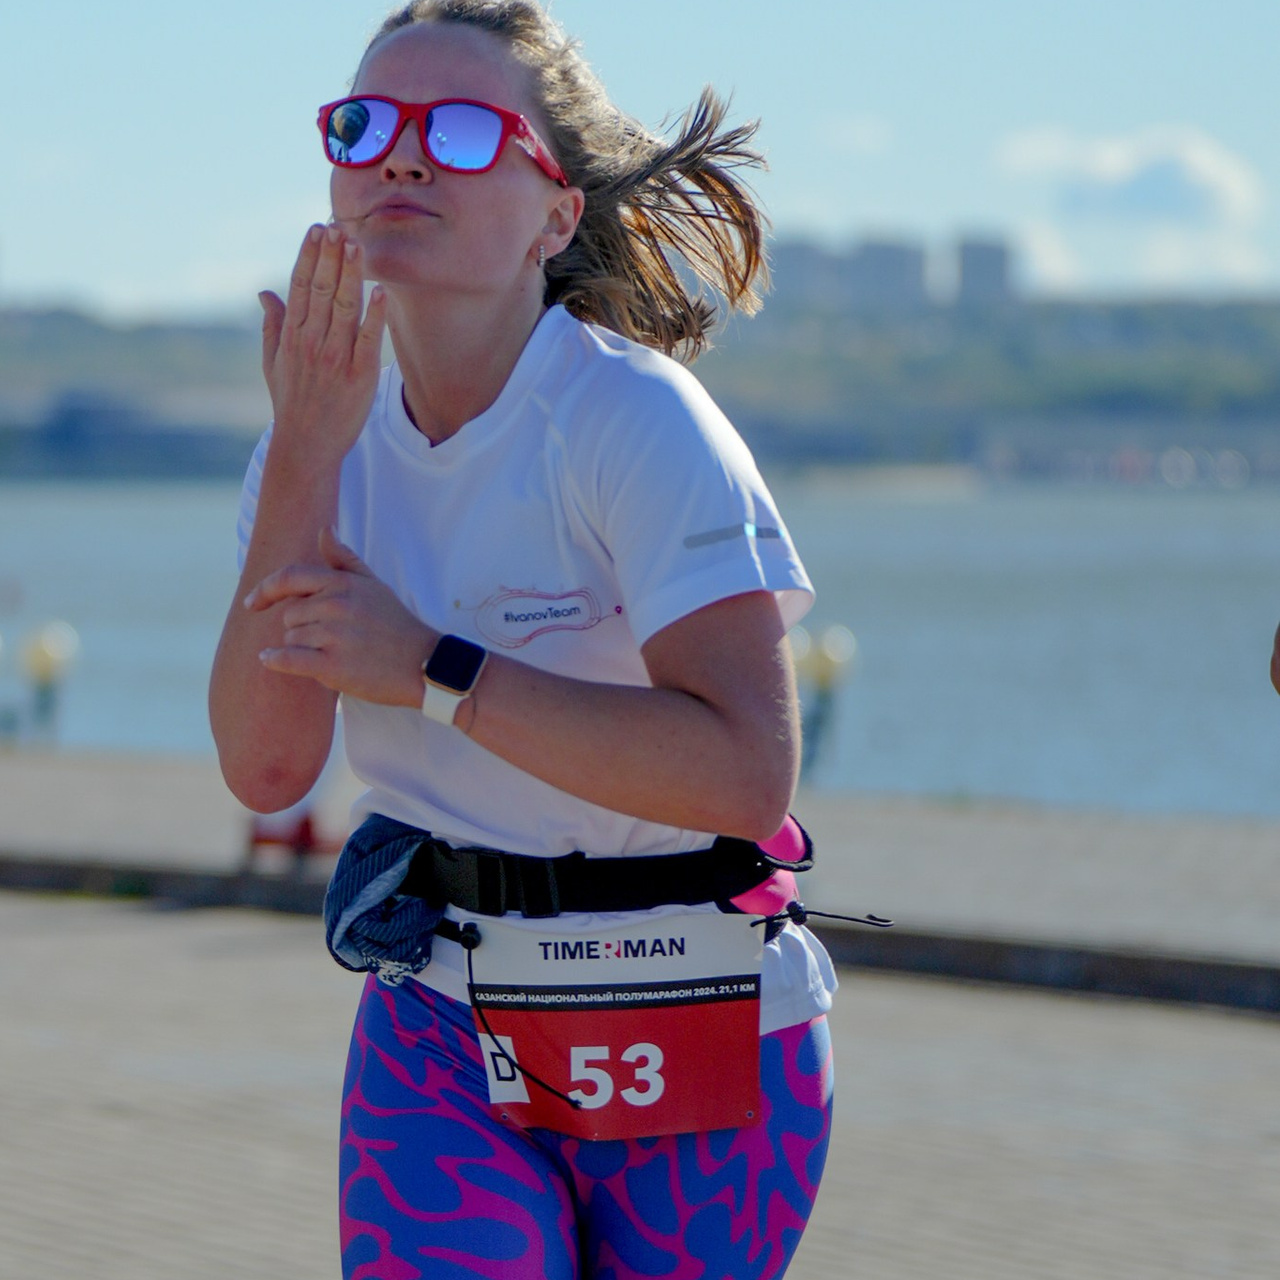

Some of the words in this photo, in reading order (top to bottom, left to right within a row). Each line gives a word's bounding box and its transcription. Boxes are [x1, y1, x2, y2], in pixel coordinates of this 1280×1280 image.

[504, 606, 581, 623] #IvanovTeam
[528, 992, 614, 1003] НАЦИОНАЛЬНЫЙ
[615, 989, 693, 1001] ПОЛУМАРАФОН
[694, 987, 718, 996] 2024.
[719, 984, 739, 994] 21,1
[740, 983, 756, 992] КМ
[490, 1051, 517, 1082] D
[567, 1042, 666, 1110] 53
